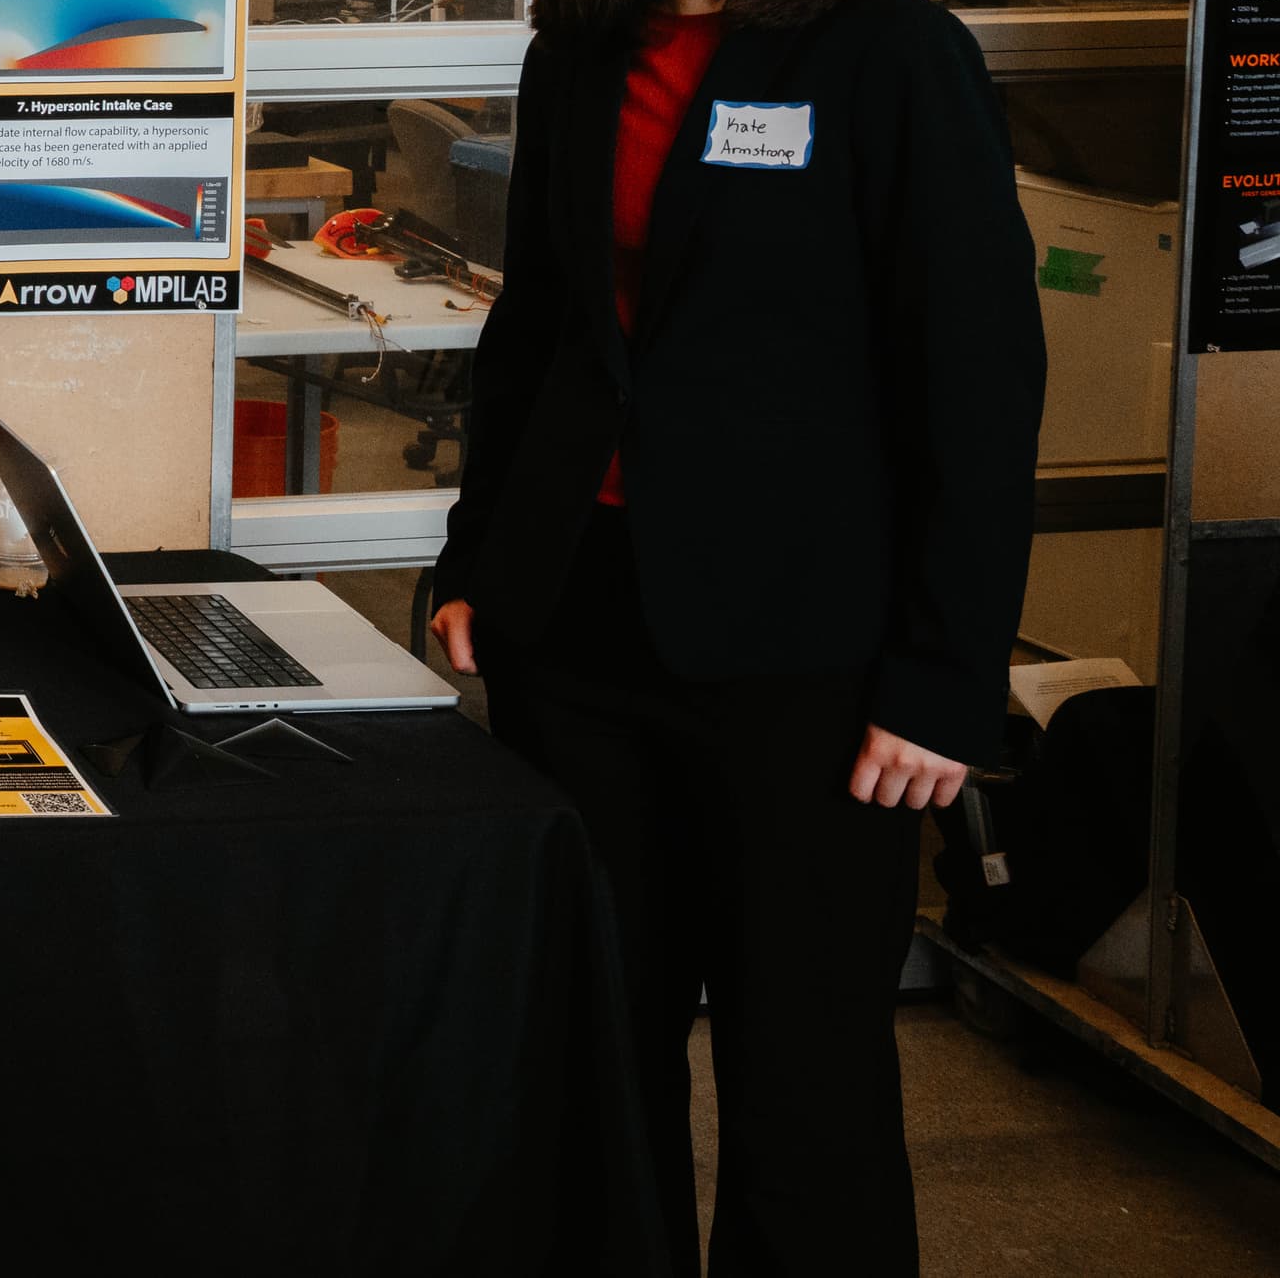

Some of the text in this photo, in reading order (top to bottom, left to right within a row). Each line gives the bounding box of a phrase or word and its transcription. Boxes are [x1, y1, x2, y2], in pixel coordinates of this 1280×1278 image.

[1230, 52, 1280, 67] WORK
[16, 98, 173, 116] 7. Hypersonic Intake Case
[726, 116, 768, 134] Kate
[720, 138, 795, 165] Armstrong
[134, 275, 228, 304] MPILAB
